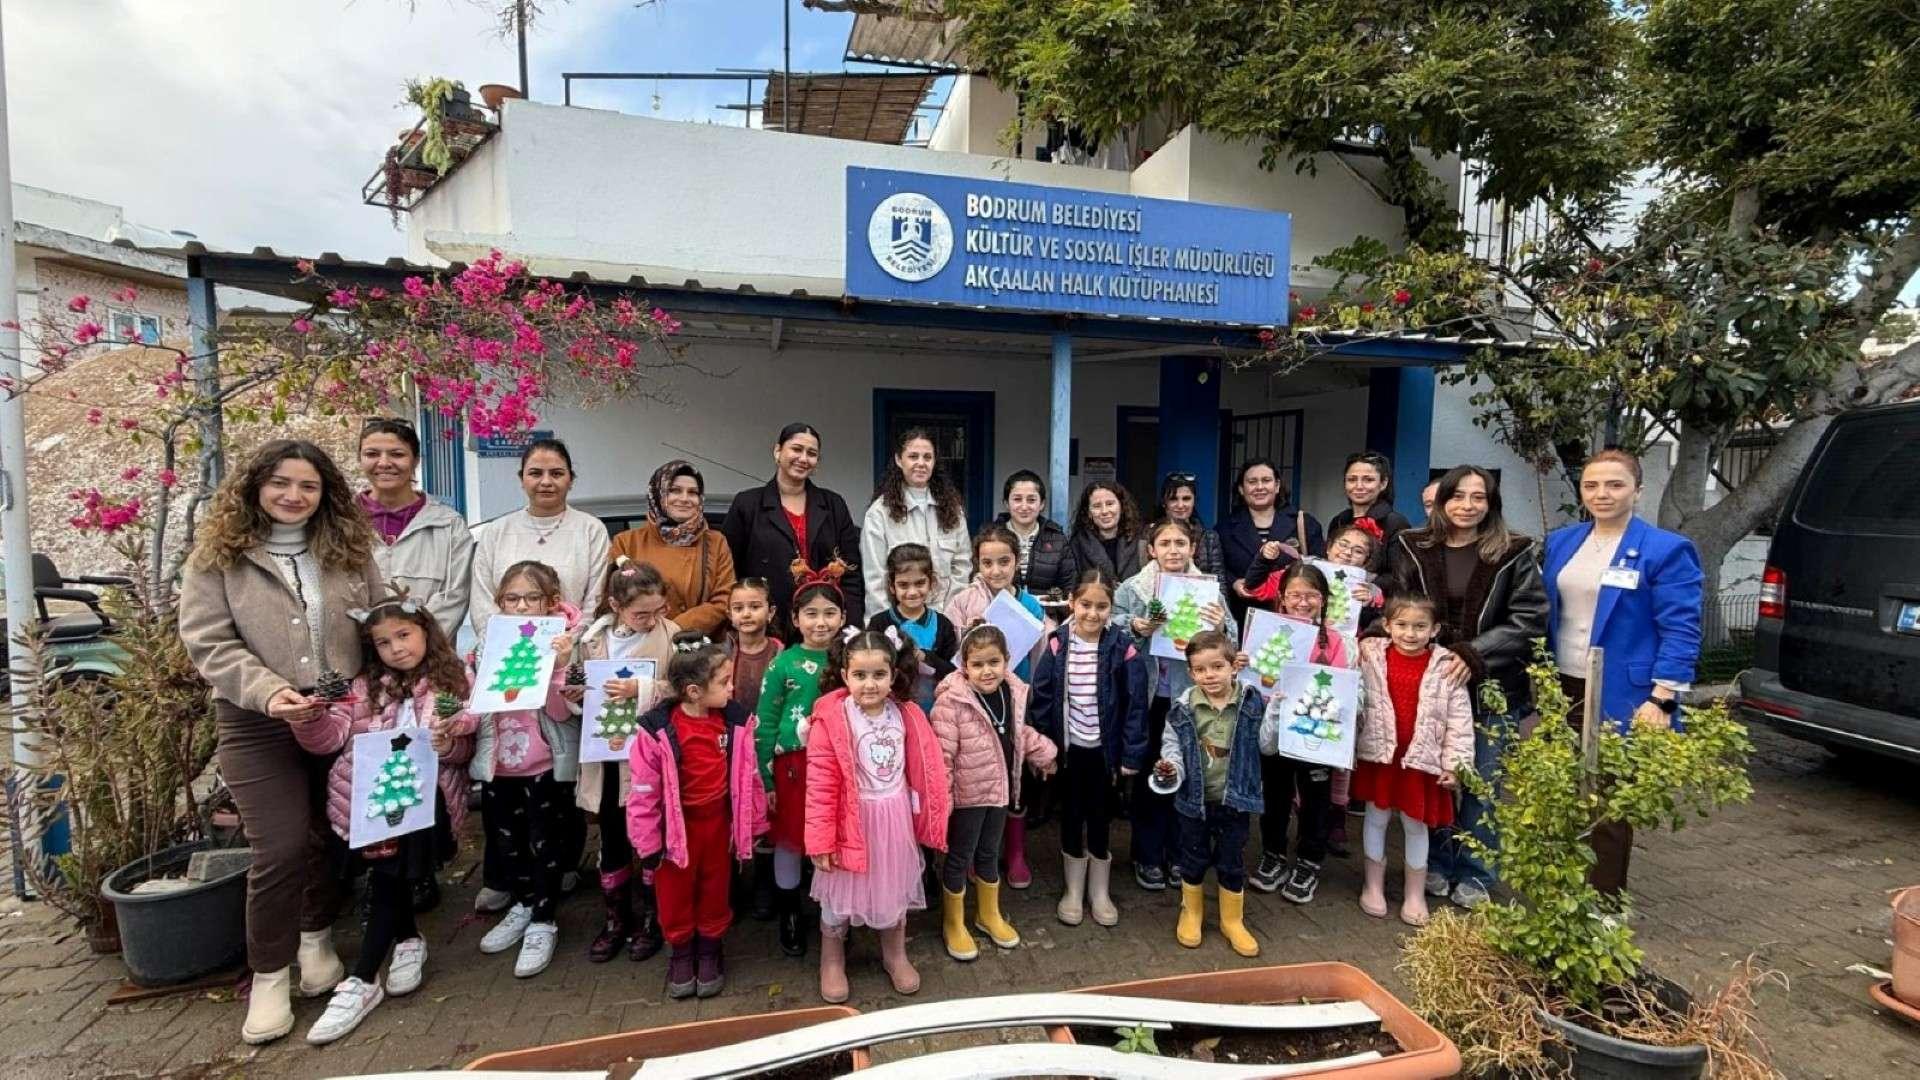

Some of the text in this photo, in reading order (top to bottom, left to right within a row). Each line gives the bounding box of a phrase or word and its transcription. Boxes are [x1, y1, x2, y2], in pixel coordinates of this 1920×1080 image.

[891, 206, 932, 217] BODRUM
[966, 193, 1142, 233] BODRUM BELEDİYESİ
[966, 223, 1275, 278] KÜLTÜR VE SOSYAL İŞLER MÜDÜRLÜĞÜ
[964, 264, 1220, 306] AKÇAALAN HALK KÜTÜPHANESİ
